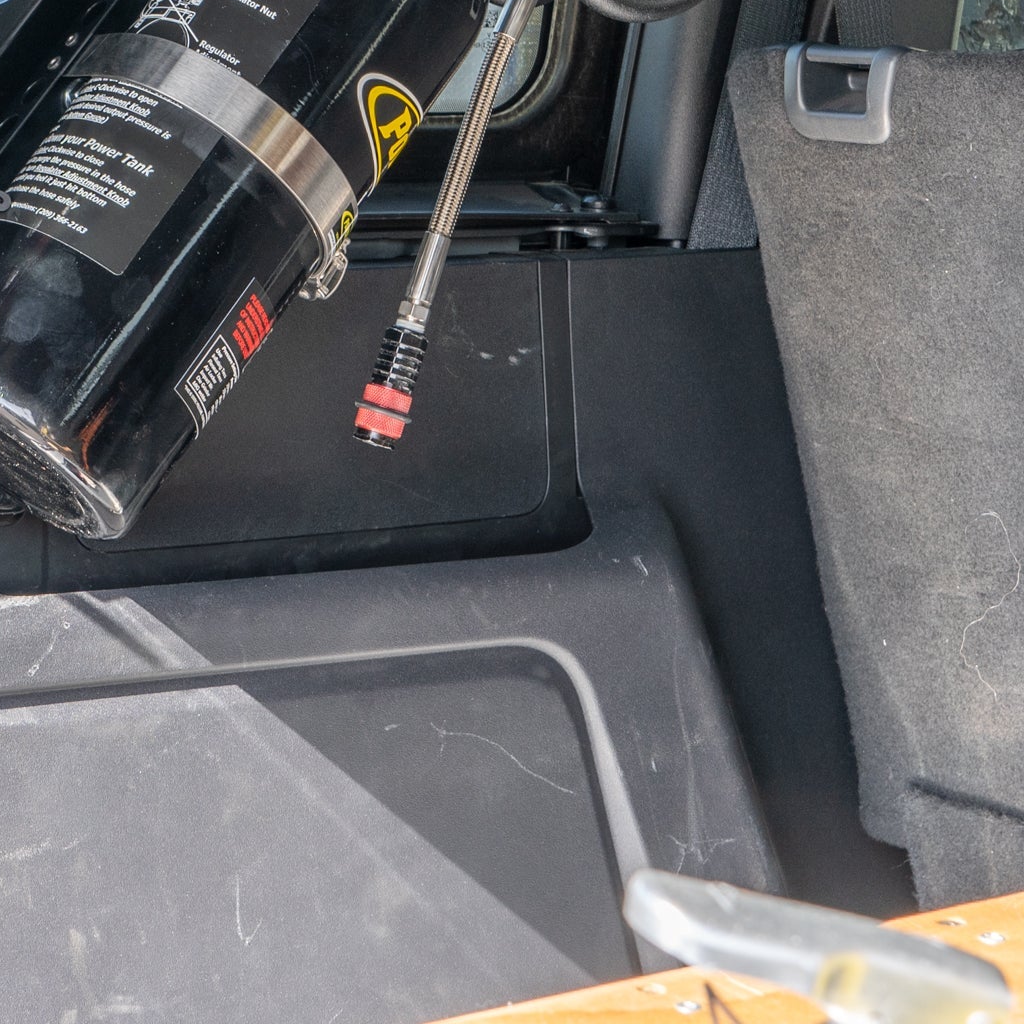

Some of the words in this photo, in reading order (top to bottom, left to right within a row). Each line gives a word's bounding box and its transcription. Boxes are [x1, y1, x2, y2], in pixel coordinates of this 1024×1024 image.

[259, 5, 278, 20] Nut
[198, 39, 241, 66] Regulator
[92, 94, 131, 108] Adjustment
[129, 102, 151, 117] Knob
[128, 90, 139, 99] to
[137, 94, 159, 107] open
[103, 106, 131, 121] output
[125, 113, 162, 135] pressure
[161, 130, 173, 140] is
[61, 134, 86, 145] your
[84, 137, 123, 160] Power
[121, 153, 155, 177] Tank
[75, 150, 85, 158] to
[83, 154, 105, 167] close
[50, 156, 62, 165] the
[59, 158, 91, 175] pressure
[90, 169, 101, 178] in
[99, 173, 115, 186] the
[114, 181, 137, 197] hose
[62, 170, 108, 194] Adjustment
[105, 189, 131, 208] Knob
[38, 188, 57, 200] hose
[56, 193, 80, 210] safely
[49, 178, 66, 189] just
[65, 183, 77, 193] hit
[76, 188, 108, 207] bottom
[35, 207, 56, 220] (209)
[52, 214, 88, 234] 366-2163
